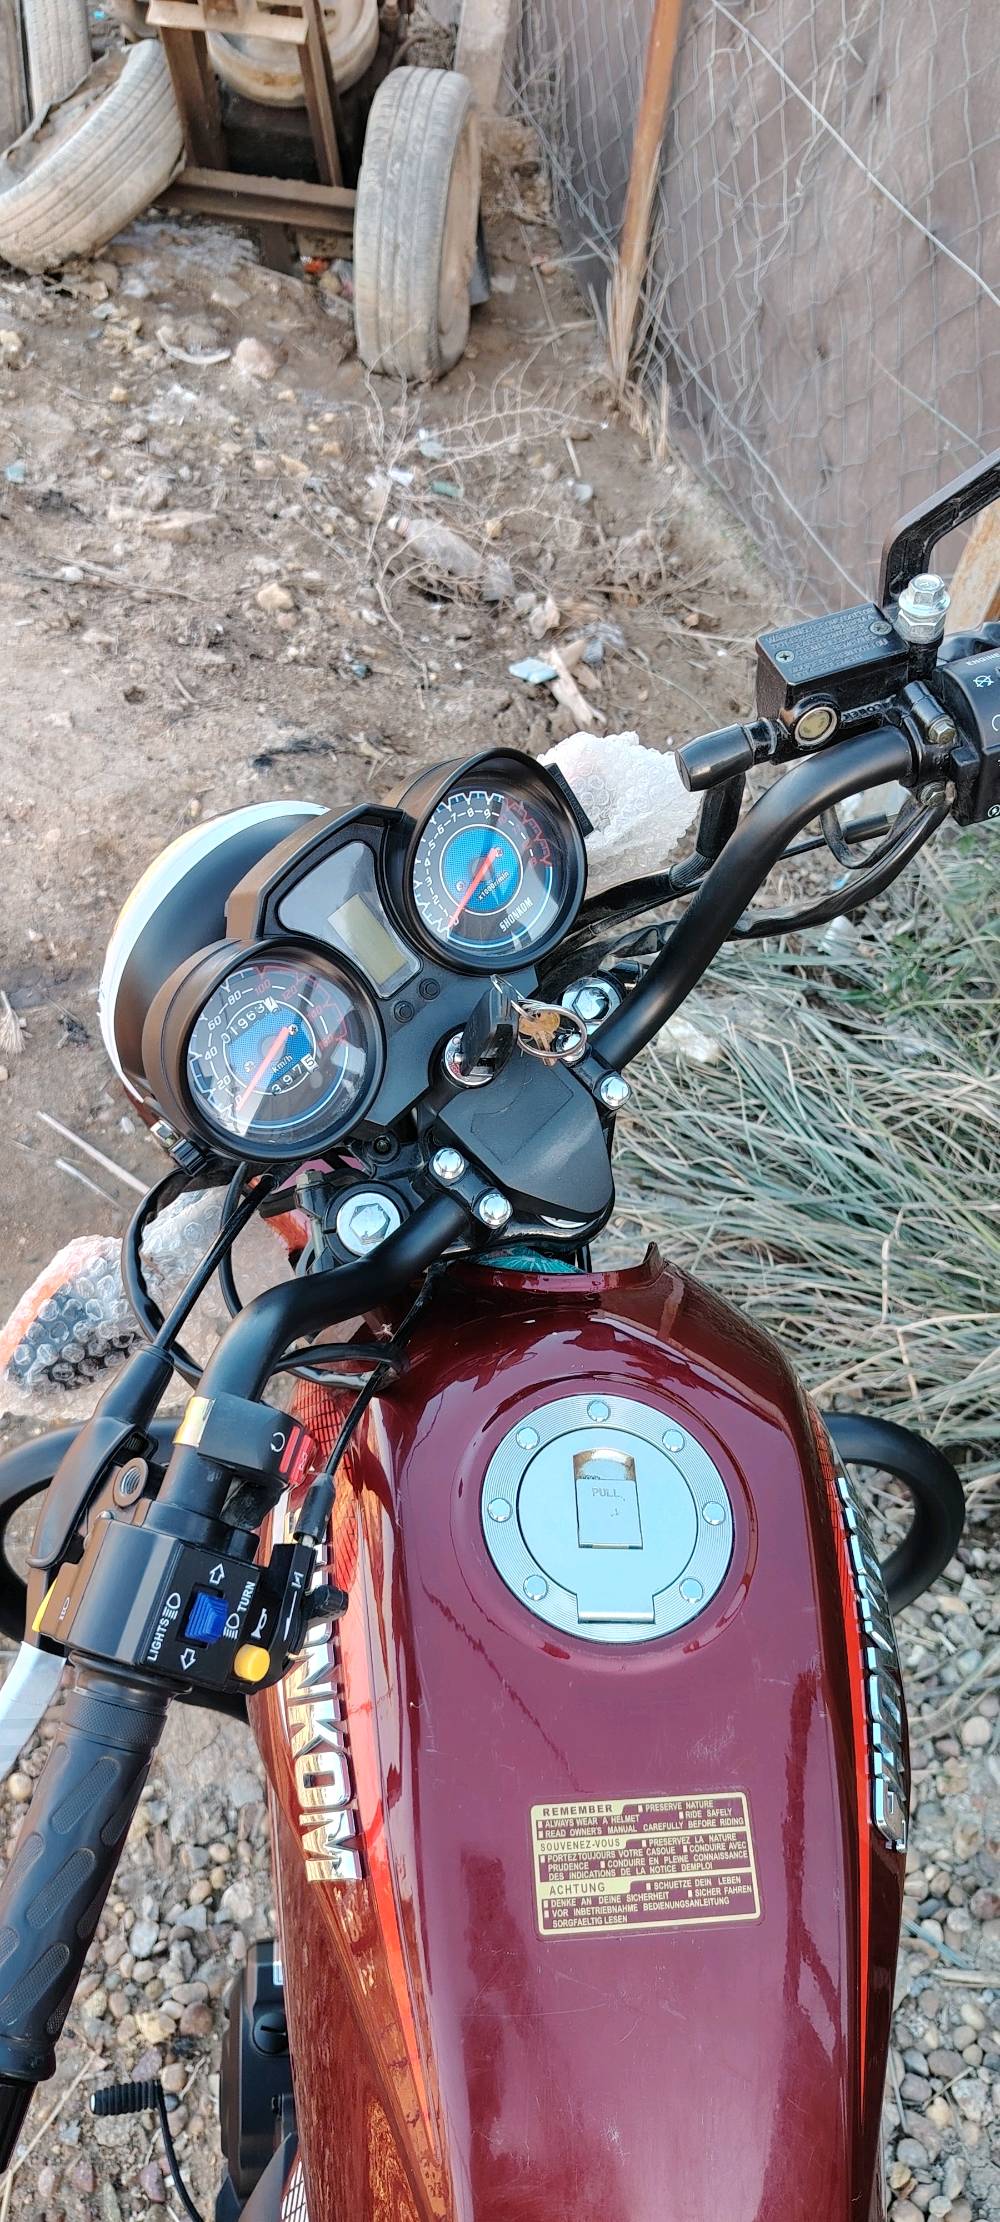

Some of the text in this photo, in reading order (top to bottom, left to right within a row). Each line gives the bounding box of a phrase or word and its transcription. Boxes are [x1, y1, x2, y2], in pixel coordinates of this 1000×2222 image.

[451, 812, 457, 822] 7
[467, 808, 474, 818] 8
[484, 809, 491, 819] 9
[437, 824, 445, 834] 6
[428, 840, 436, 850] 5
[424, 858, 431, 867] 4
[425, 877, 433, 887] 3
[432, 895, 440, 905] 2
[499, 896, 534, 932] SHONKOM
[228, 990, 242, 1005] 80
[208, 1015, 221, 1030] 60
[205, 1046, 217, 1061] 40
[271, 1055, 293, 1073] km/h
[217, 1075, 231, 1090] 20
[592, 1487, 620, 1498] PULL
[237, 1581, 256, 1612] TURN
[147, 1618, 169, 1662] LIGHTS
[542, 1804, 613, 1817] REMEMBER
[645, 1800, 714, 1812] PRESERVE NATURE
[685, 1808, 732, 1818] RIDE SAFELY
[545, 1814, 640, 1828] ALWAYS WEAR A HELMET
[545, 1829, 566, 1838] READ
[607, 1824, 637, 1834] MANUAL
[643, 1821, 684, 1832] CAREFULLY
[688, 1819, 717, 1828] BEFORE
[720, 1817, 744, 1826] RIDING
[540, 1838, 621, 1852] SOUVENEZ-VOUS
[649, 1833, 737, 1847] PRESERVEZ LA NATURE
[547, 1852, 577, 1863] PORTEZ
[577, 1850, 616, 1861] TOUJOURS
[618, 1849, 643, 1859] VOTRE
[689, 1843, 726, 1853] CONDUIRE
[728, 1841, 747, 1850] AVEC
[548, 1850, 749, 1872] PRUDENCE CONDUIRE EN PLEINE CONNAISSANCE
[548, 1872, 564, 1880] DES
[569, 1869, 616, 1879] INDICATIONS
[620, 1867, 631, 1876] DE
[635, 1866, 646, 1875] LA
[650, 1864, 677, 1874] NOTICE
[549, 1882, 606, 1896] ACHTUNG
[653, 1875, 741, 1890] SCHUETZE DEIN LEBEN
[551, 1885, 752, 1907] DENKE AN DEINE SICHERHEIT SICHER FAHREN
[552, 1896, 730, 1918] VOR INBETRIEBNAHME BEDIENUNGSANLEITUNG
[552, 1915, 628, 1928] SORGFAELTIG LESEN
